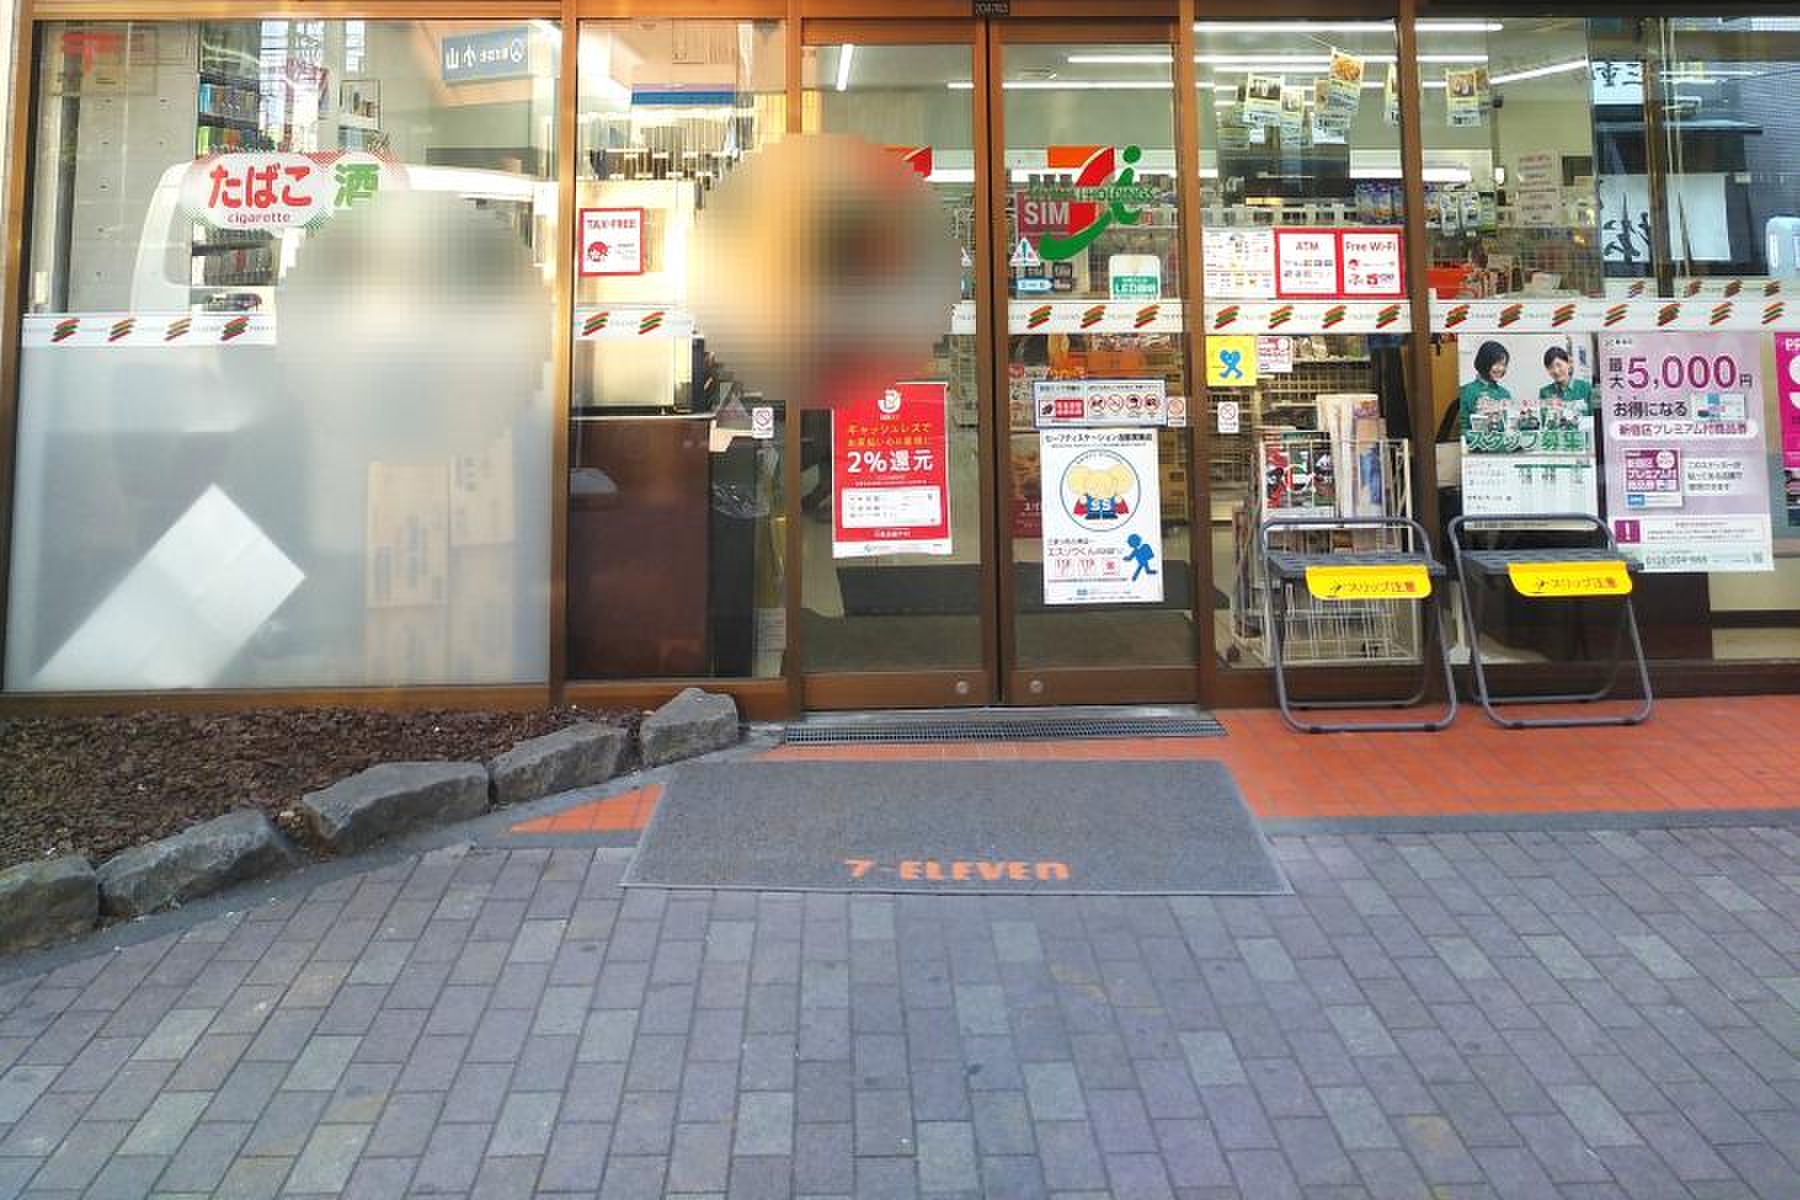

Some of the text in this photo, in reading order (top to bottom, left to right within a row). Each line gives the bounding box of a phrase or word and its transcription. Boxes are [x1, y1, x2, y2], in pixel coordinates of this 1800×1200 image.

[208, 163, 312, 209] たばこ
[334, 162, 380, 208] 酒
[227, 212, 292, 226] cigarette
[1023, 201, 1070, 225] SIM
[1295, 241, 1320, 251] ATM
[1345, 241, 1397, 252] Free Wi-Fi
[1609, 357, 1625, 389] 最大
[1613, 400, 1688, 418] お得になる
[847, 449, 934, 474] 2%還元
